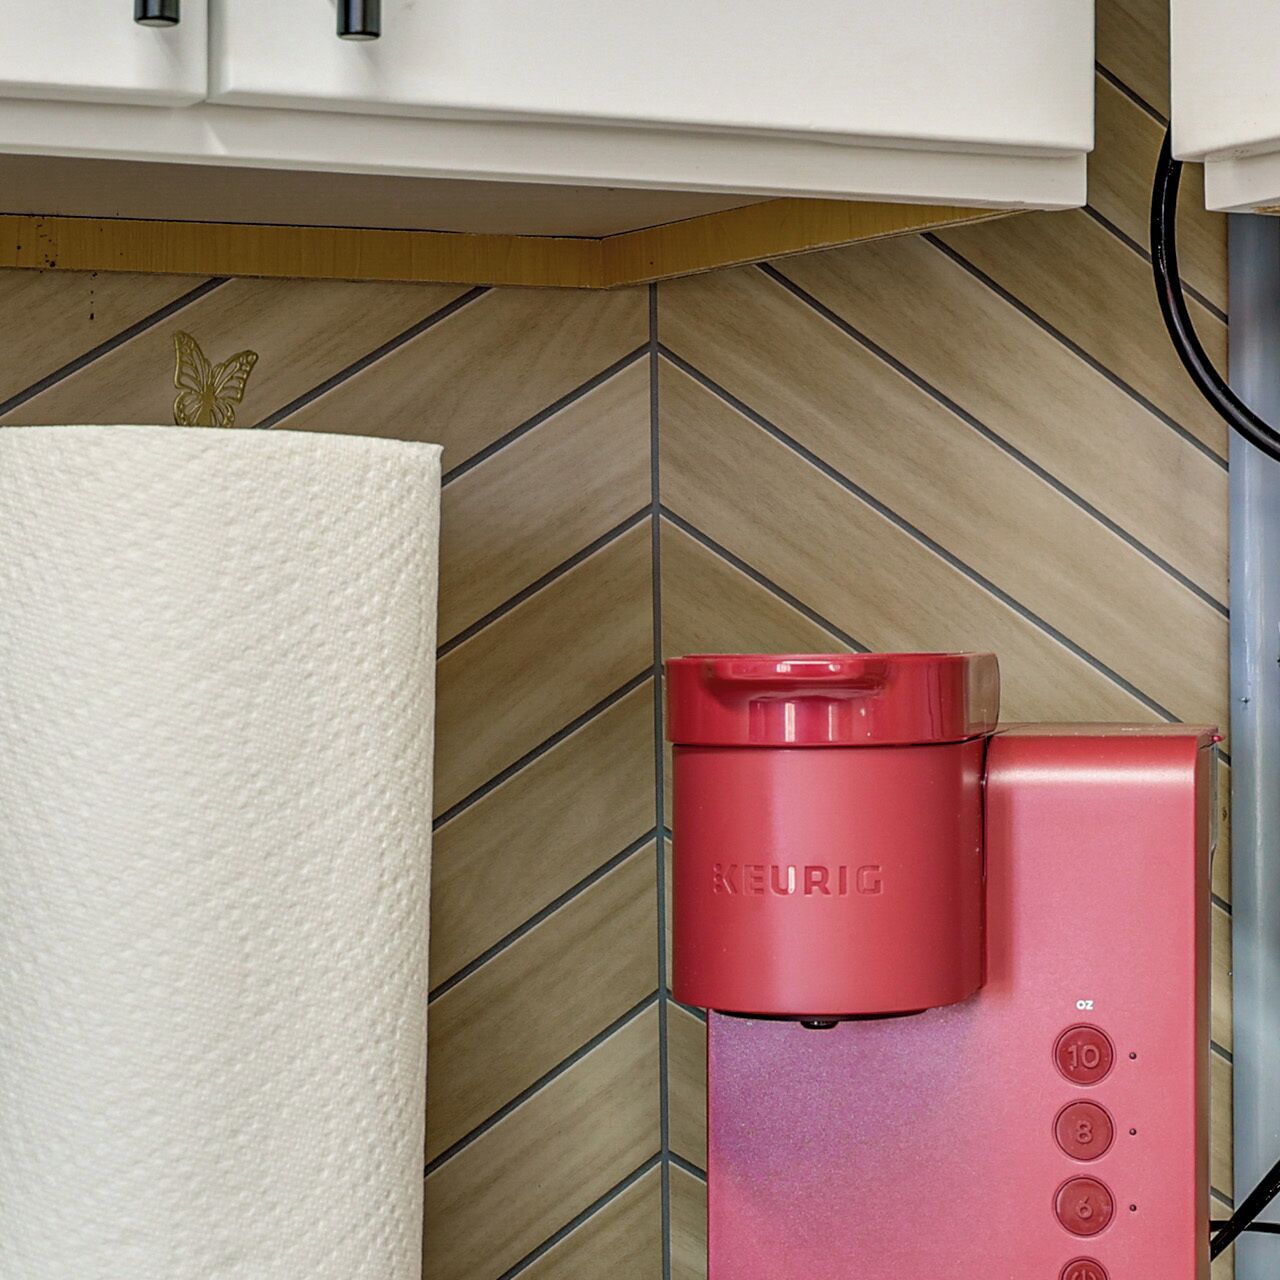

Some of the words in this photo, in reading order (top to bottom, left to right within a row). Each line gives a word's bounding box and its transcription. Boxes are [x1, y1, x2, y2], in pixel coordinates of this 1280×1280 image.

[713, 864, 883, 896] KEURIG
[1068, 1045, 1100, 1068] 10
[1076, 1121, 1092, 1143] 8
[1077, 1197, 1092, 1219] 6
